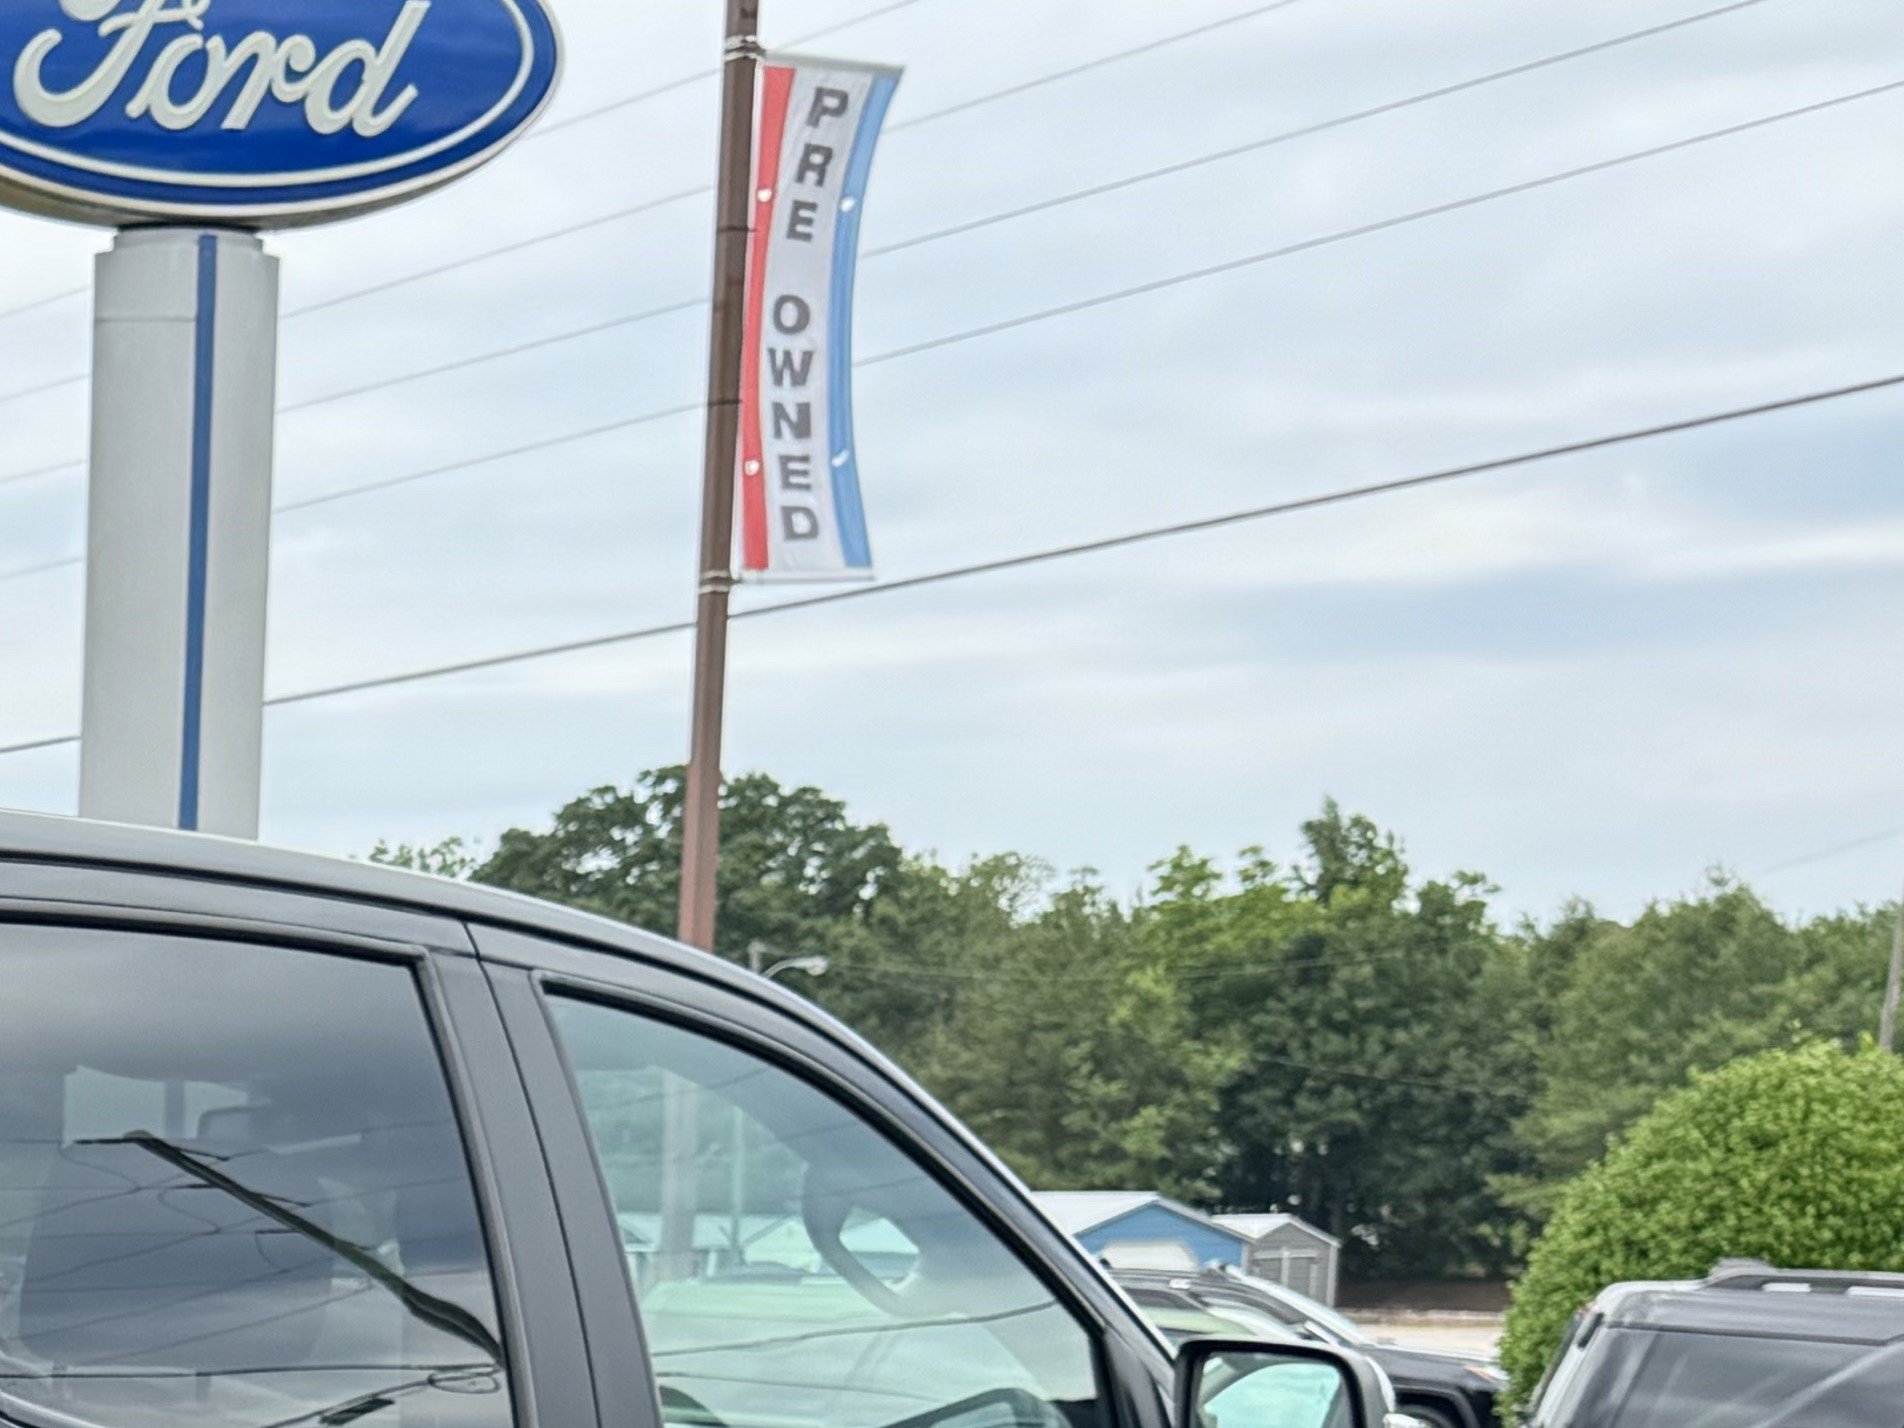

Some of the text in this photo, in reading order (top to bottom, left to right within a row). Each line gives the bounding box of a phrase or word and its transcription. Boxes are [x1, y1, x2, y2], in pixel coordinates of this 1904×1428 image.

[12, 0, 432, 138] Ford
[767, 86, 849, 543] PRE OWNED
